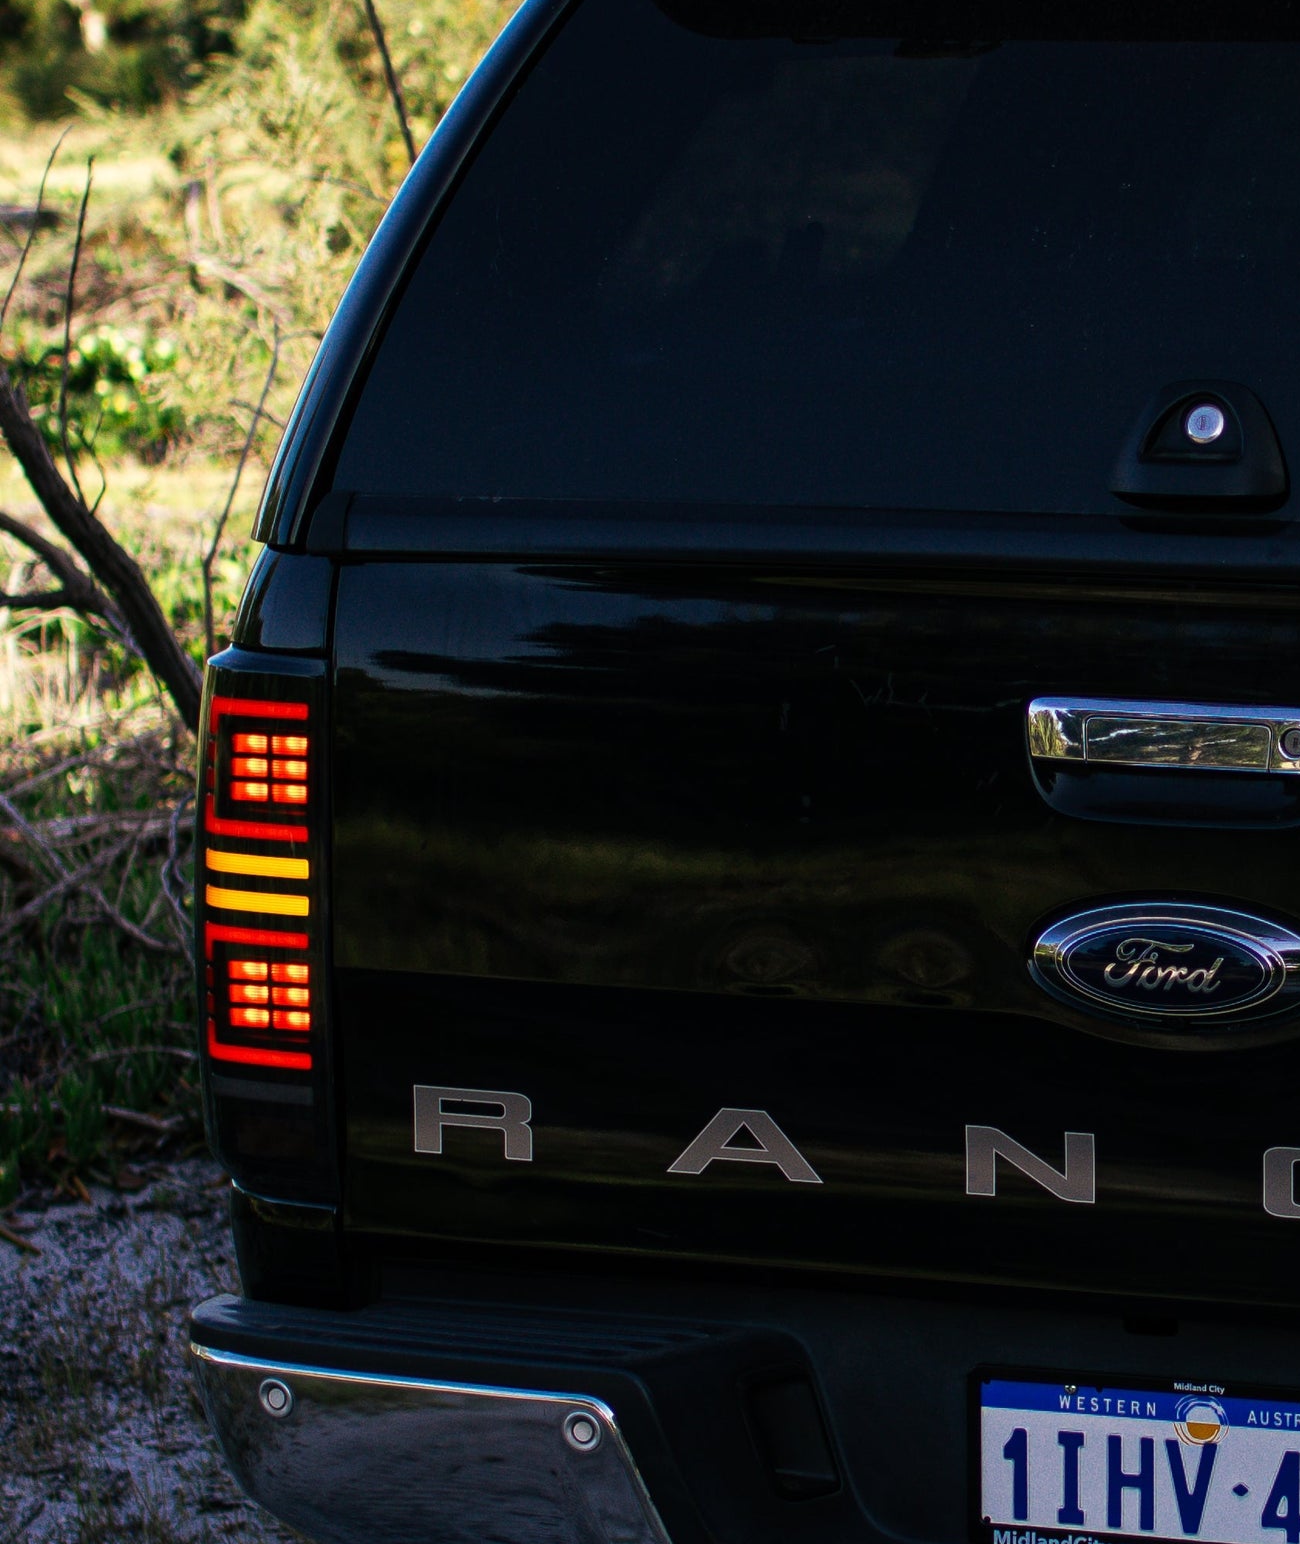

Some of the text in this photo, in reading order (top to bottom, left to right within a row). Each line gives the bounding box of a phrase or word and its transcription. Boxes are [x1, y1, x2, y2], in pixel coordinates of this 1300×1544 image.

[1103, 937, 1225, 994] Ford
[1173, 1382, 1226, 1396] Midland City
[1058, 1394, 1157, 1417] WESTERN
